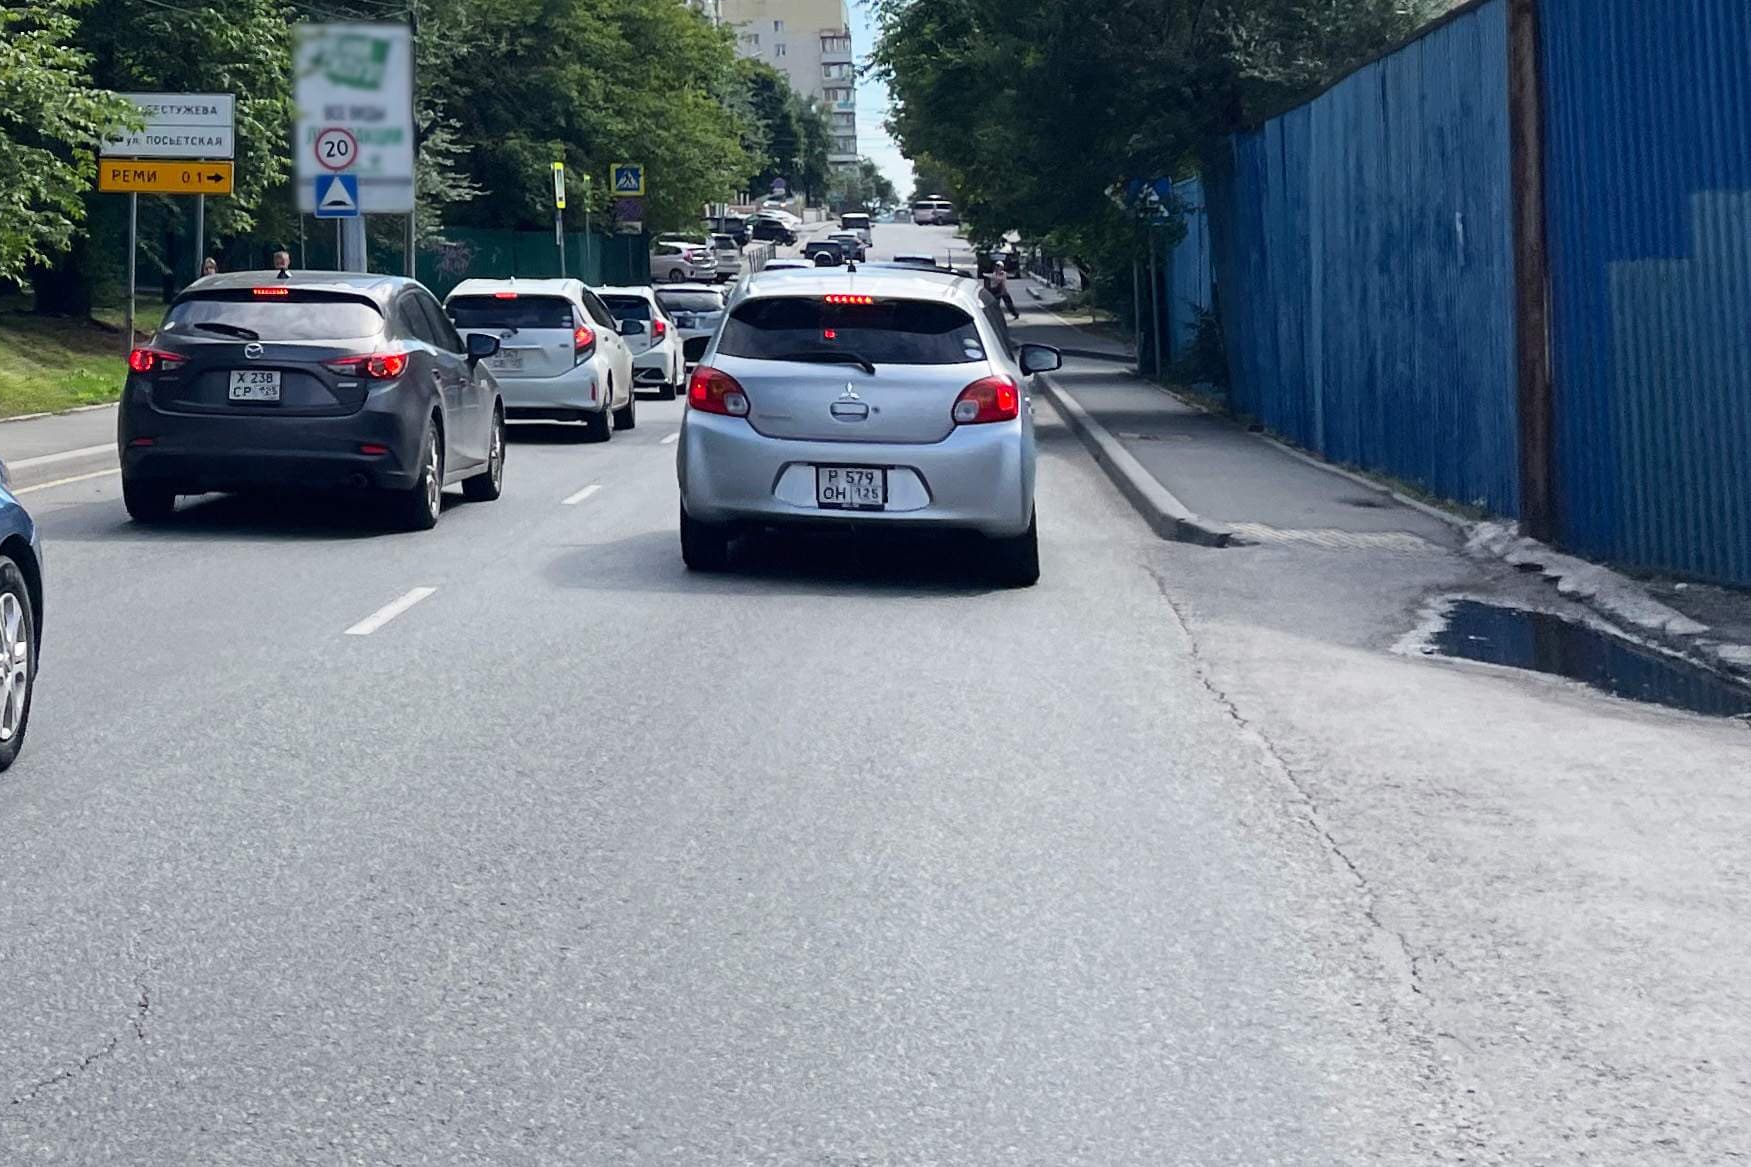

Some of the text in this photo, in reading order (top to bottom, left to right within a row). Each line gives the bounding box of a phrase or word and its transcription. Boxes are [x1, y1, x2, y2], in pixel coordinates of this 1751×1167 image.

[146, 135, 222, 147] ПОСЬЕТСКАЯ
[324, 139, 349, 158] 20
[111, 169, 157, 183] РЕМИ
[846, 470, 874, 485] 579
[855, 487, 879, 499] 125
